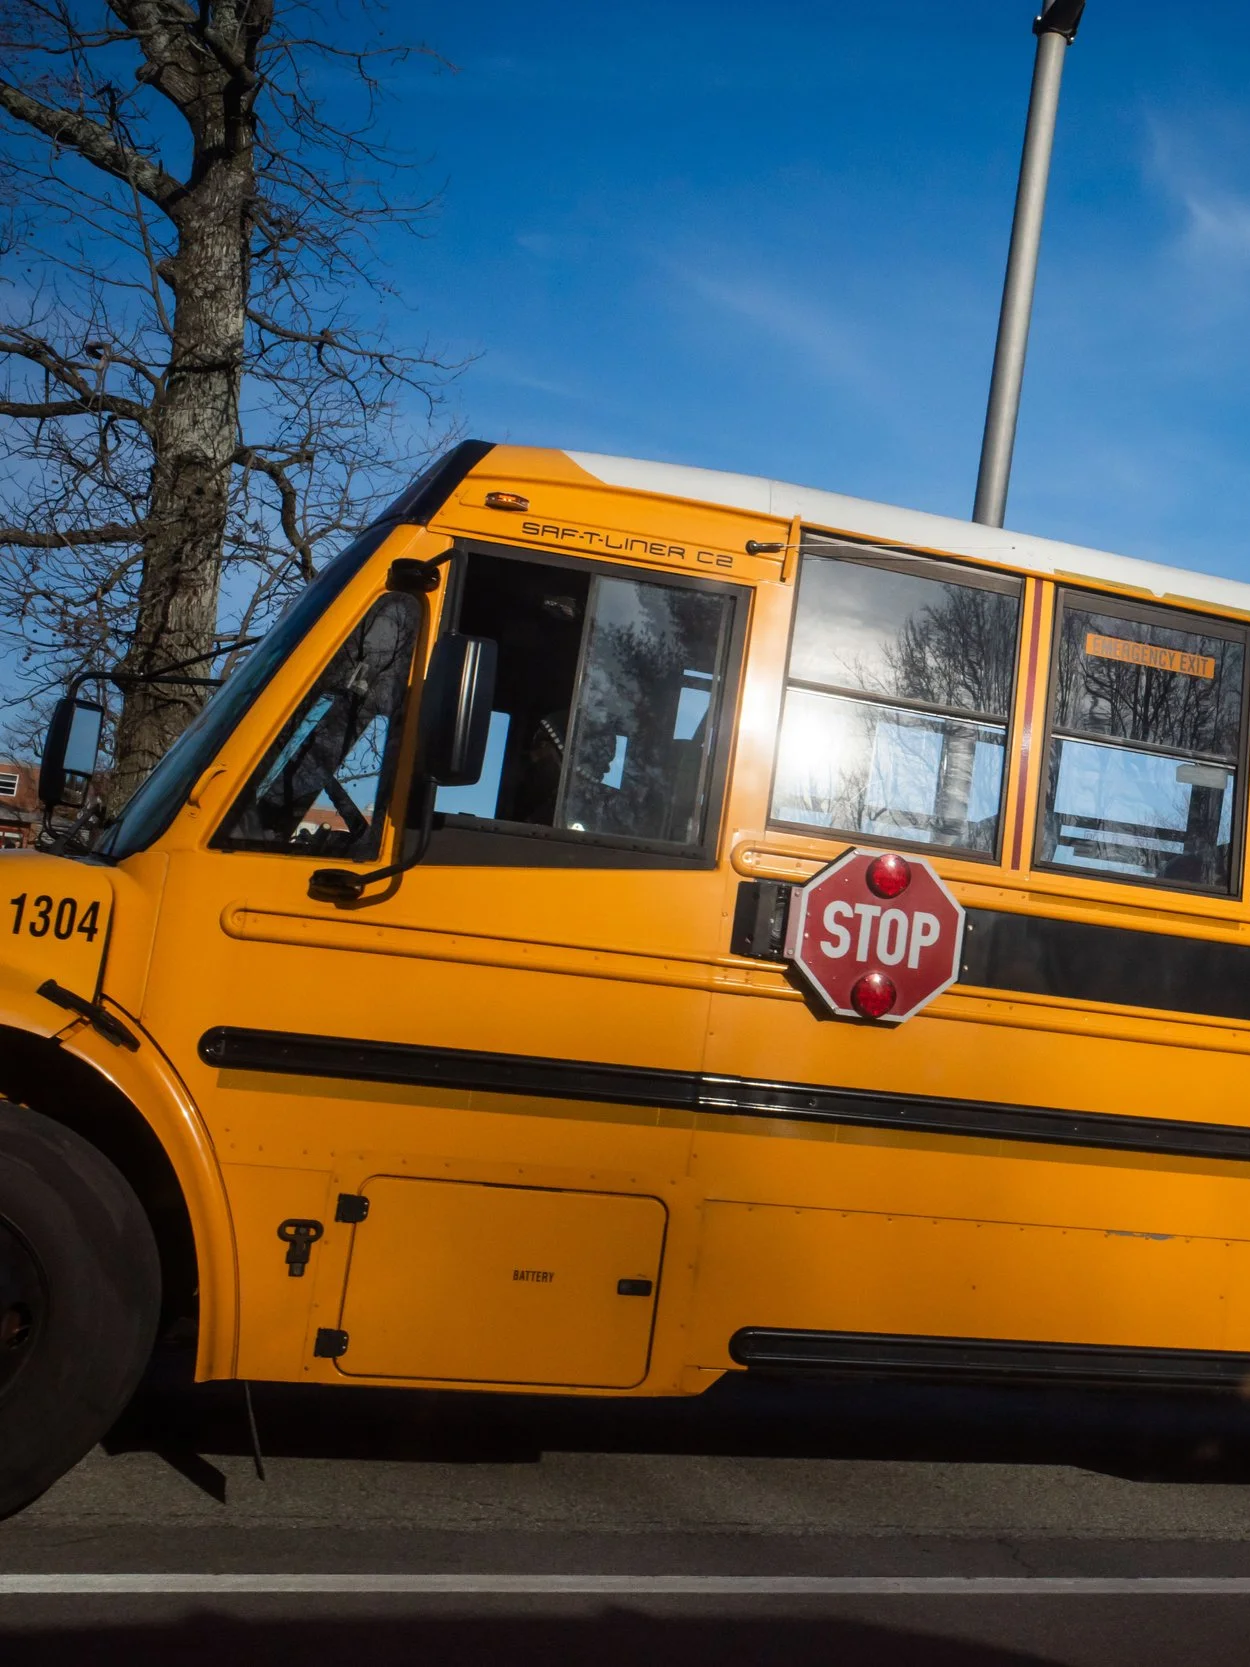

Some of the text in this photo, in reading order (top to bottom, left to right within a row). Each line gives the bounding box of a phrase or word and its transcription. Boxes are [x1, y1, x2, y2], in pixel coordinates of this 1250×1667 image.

[522, 521, 734, 568] SAF-T-LINER C2
[1092, 637, 1209, 676] EMERGENCY EXIT
[10, 892, 101, 943] 1304
[820, 900, 941, 970] STOP
[512, 1269, 555, 1283] BATTERY
